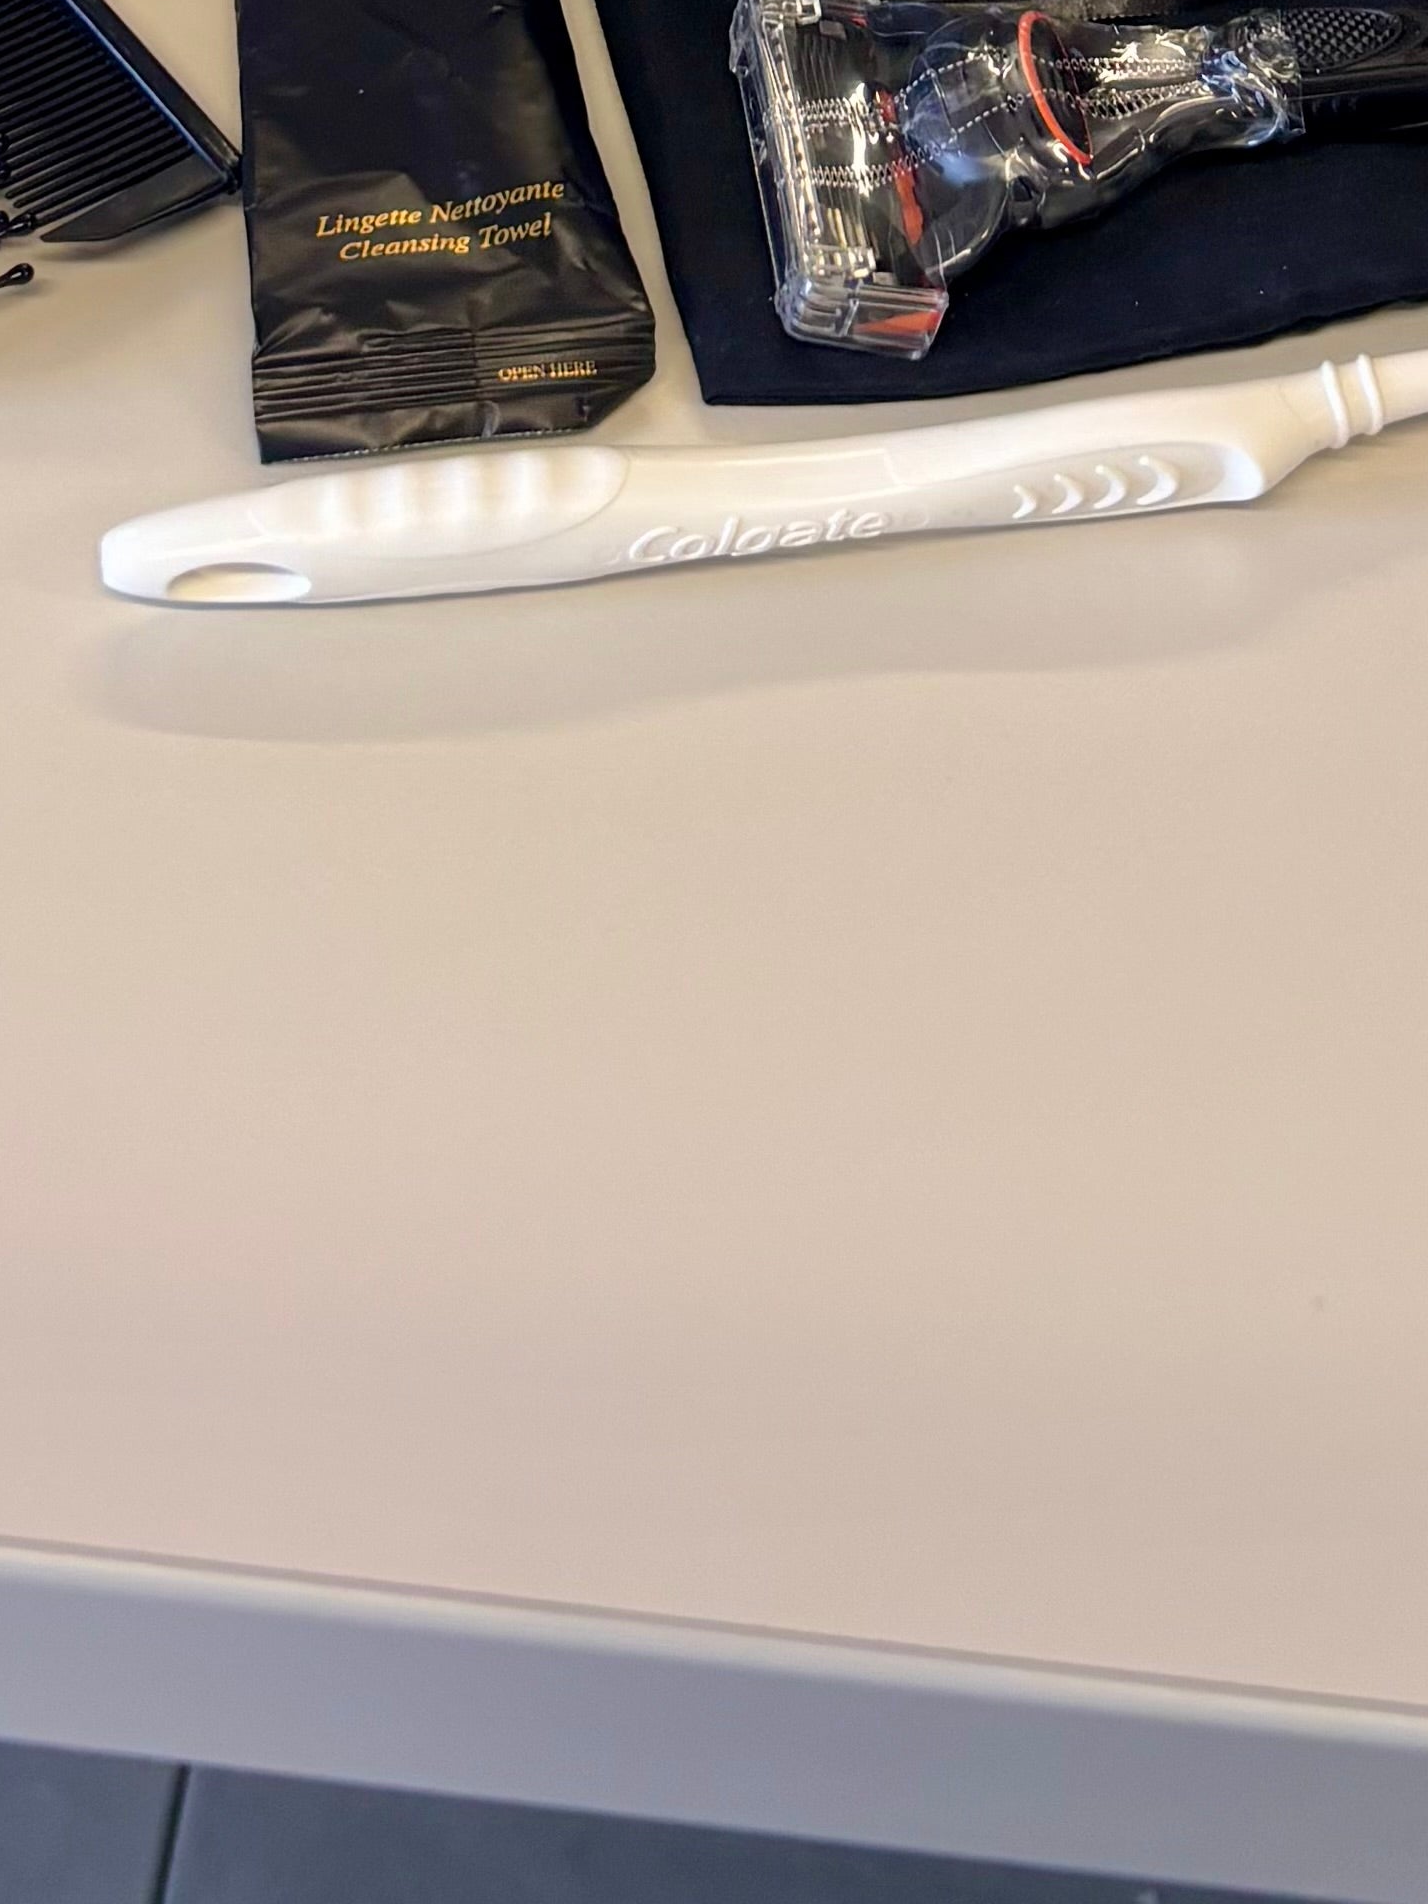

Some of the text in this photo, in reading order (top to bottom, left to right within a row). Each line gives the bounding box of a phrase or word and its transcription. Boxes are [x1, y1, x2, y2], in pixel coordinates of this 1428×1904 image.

[316, 180, 566, 238] Lingette Nettoyante
[338, 212, 553, 261] Cleansing Towel
[497, 359, 598, 382] OPEN HERE
[628, 508, 894, 563] Colgate
